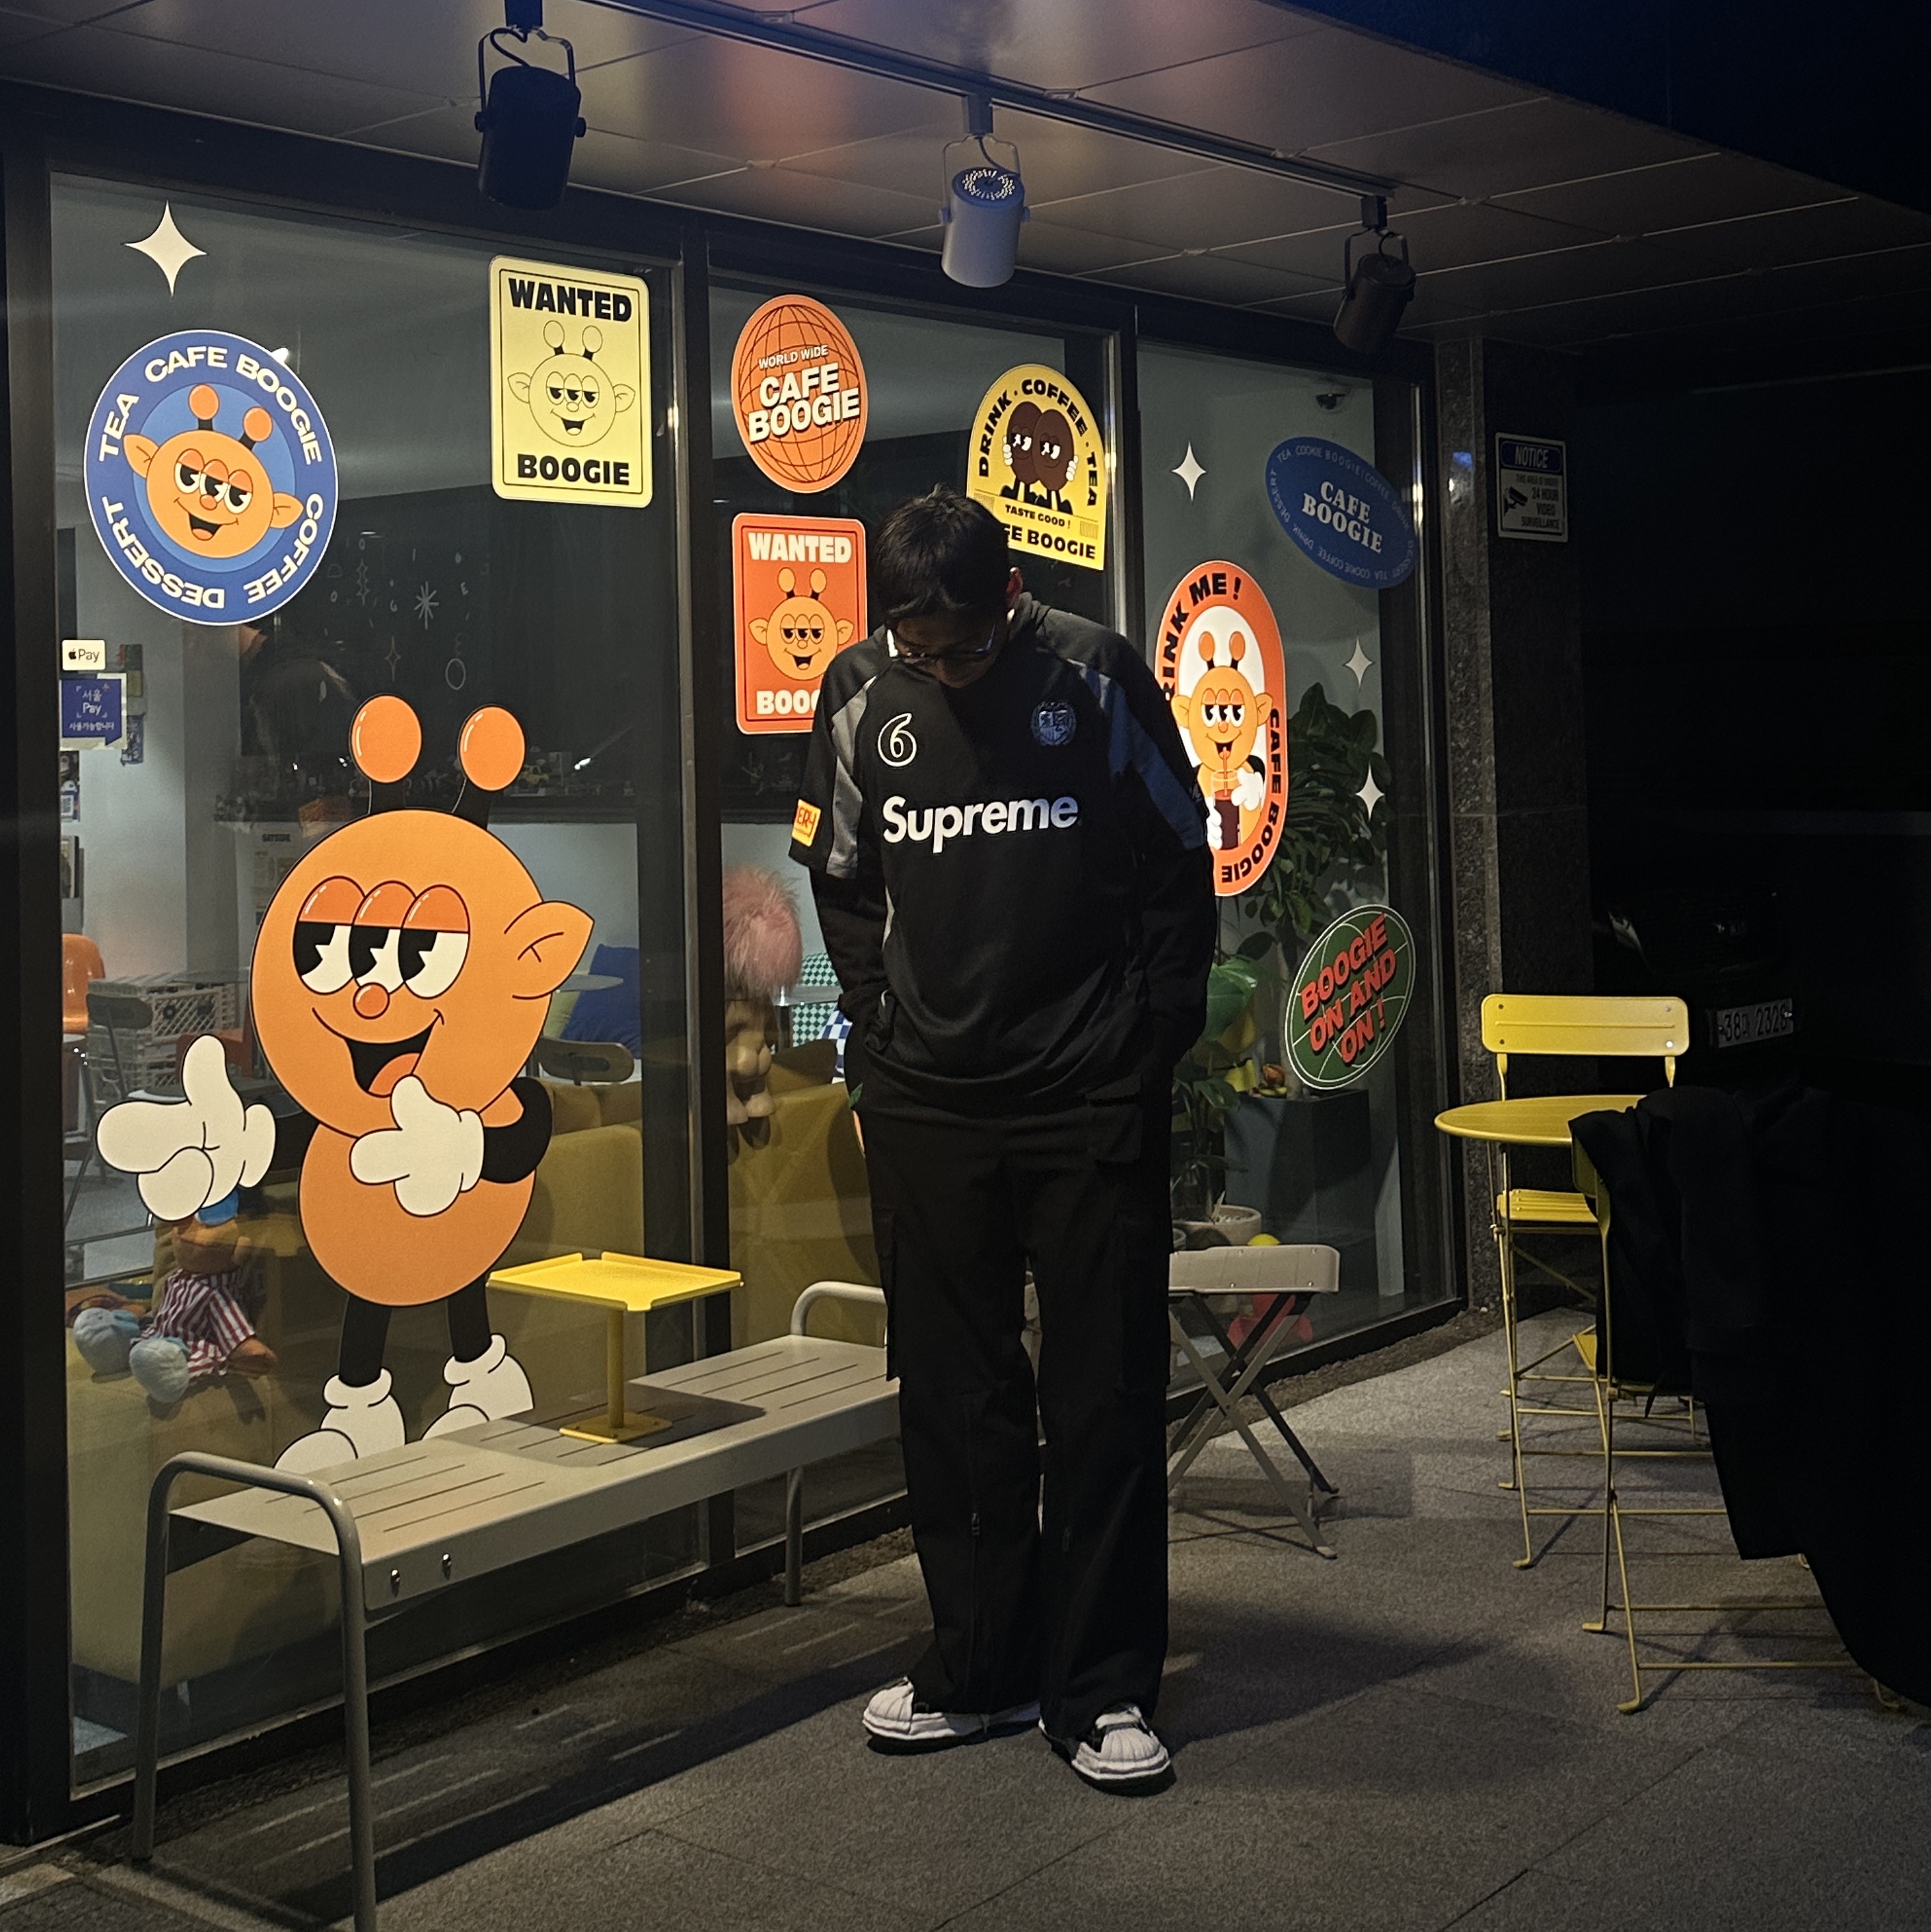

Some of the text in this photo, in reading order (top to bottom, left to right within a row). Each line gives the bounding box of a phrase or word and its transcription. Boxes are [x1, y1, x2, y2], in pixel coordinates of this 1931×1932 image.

[507, 277, 632, 322] WANTED
[758, 344, 829, 371] WORLD WIDE
[759, 362, 841, 408] CAFE
[748, 387, 860, 444] BOOGIE
[978, 379, 1098, 506] DRINK COFFEE TEA
[1515, 445, 1549, 469] NOTICE
[99, 346, 323, 609] TEA CAFE BOOGIE COFFEE DESSERT
[517, 454, 630, 486] BOOGIE
[1005, 504, 1035, 520] TASTE
[1320, 480, 1371, 524] CAFE
[1531, 487, 1559, 502] 24 HOUR
[1027, 529, 1096, 560] BOOGIE
[1301, 492, 1383, 554] BOOGIE
[748, 532, 852, 564] WANTED
[78, 648, 100, 663] Pay
[82, 688, 103, 702] 서울
[82, 702, 102, 716] Pay
[877, 712, 917, 767] 6
[1270, 707, 1283, 795] CAFE
[882, 794, 1080, 854] Supreme
[1221, 801, 1280, 883] BOOGIE
[1300, 912, 1387, 1020] BOOGIE
[1309, 948, 1396, 1052] ON AND
